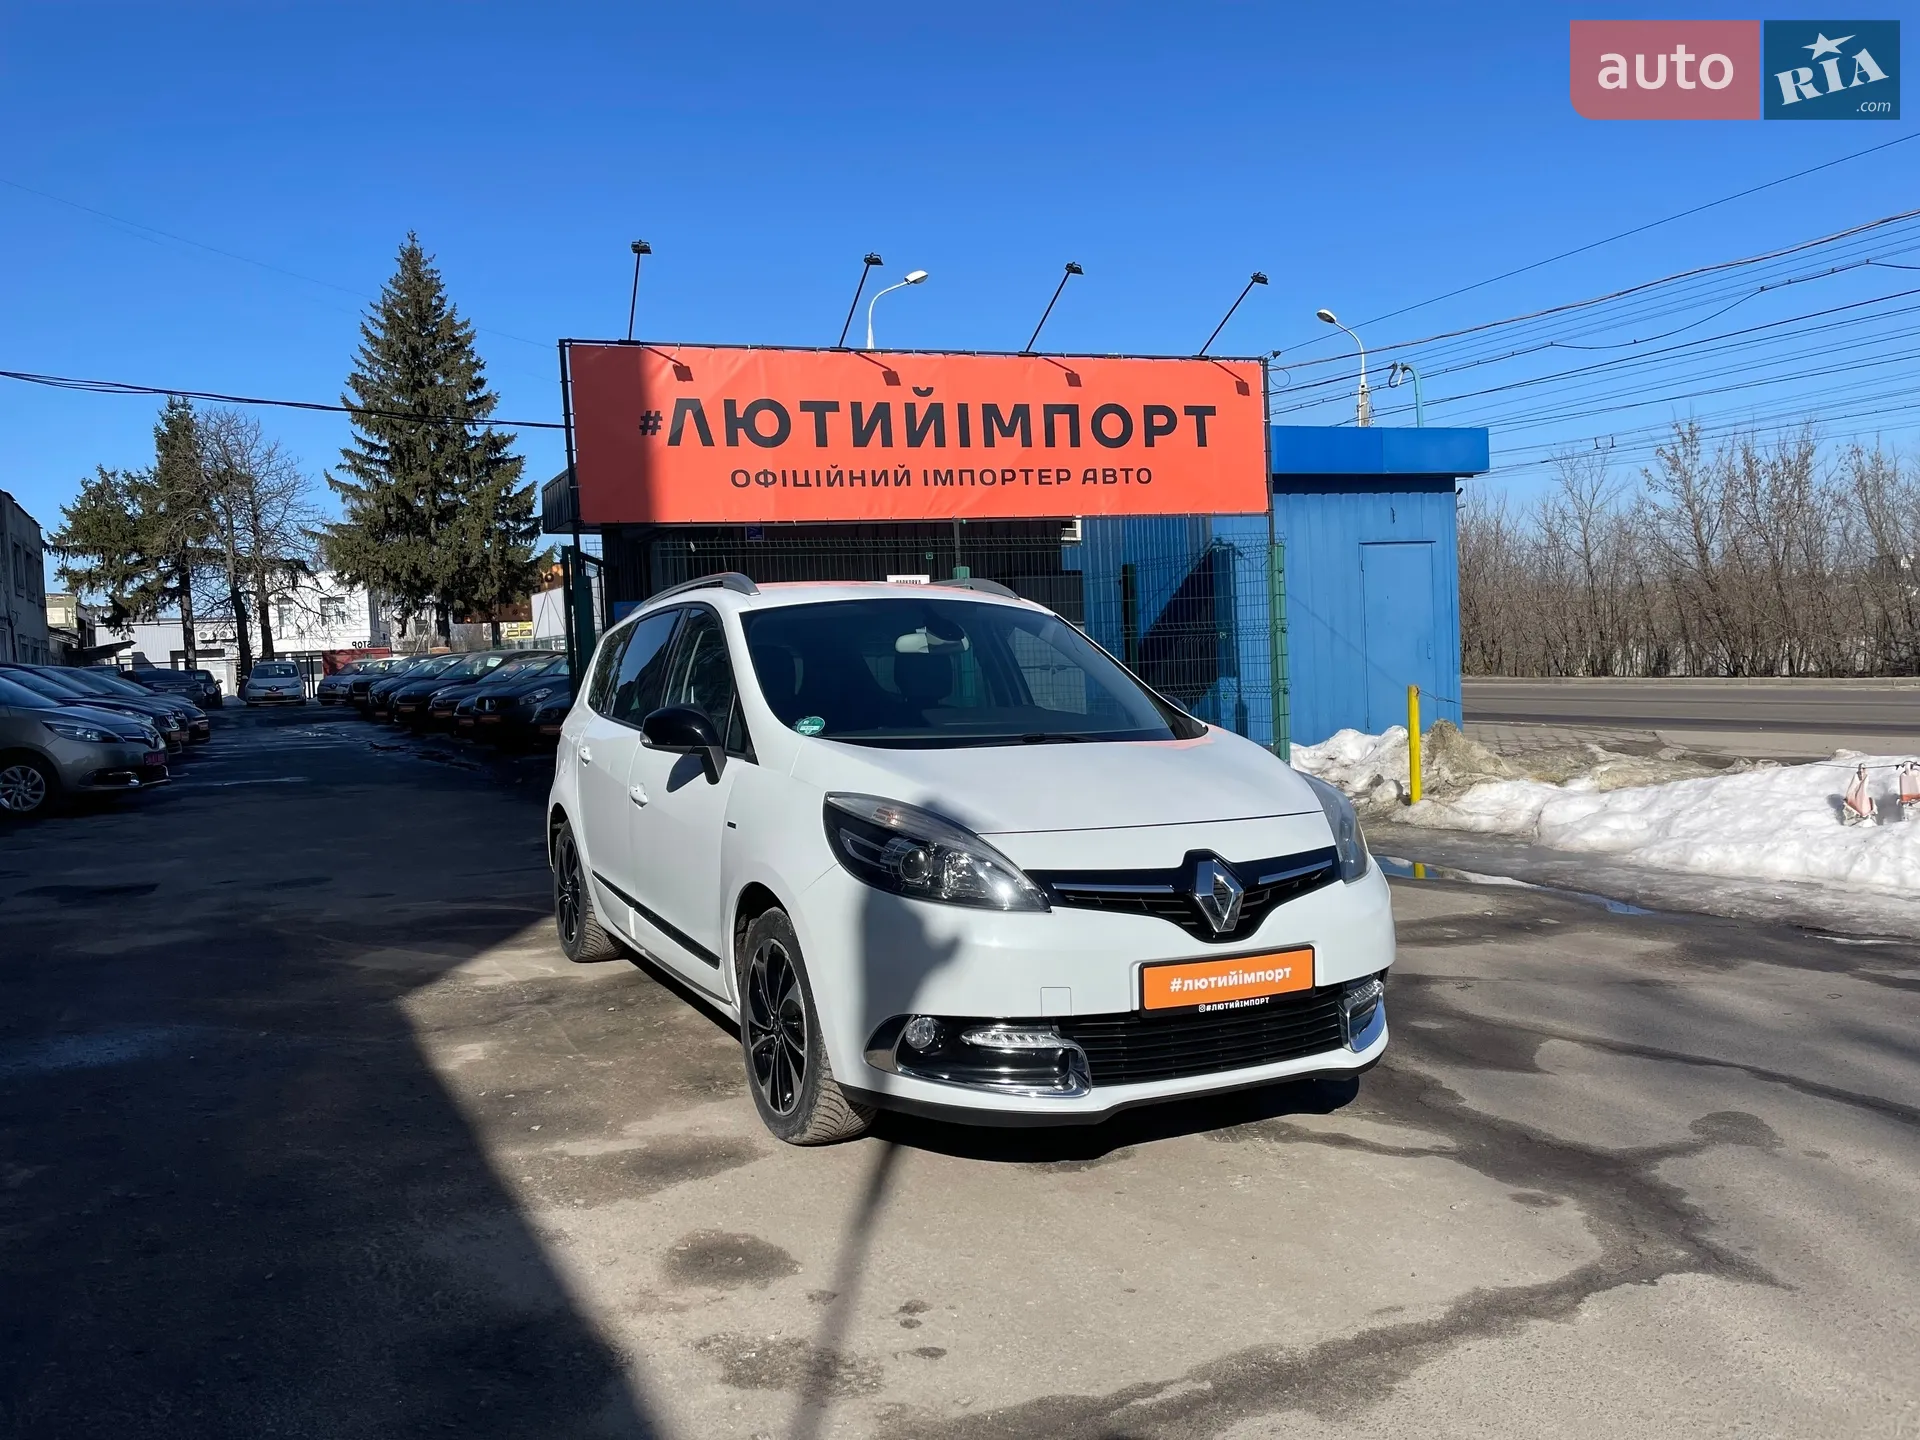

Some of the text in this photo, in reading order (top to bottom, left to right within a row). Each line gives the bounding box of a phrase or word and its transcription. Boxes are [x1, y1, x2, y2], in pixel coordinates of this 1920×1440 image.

[639, 385, 1217, 449] #ЛЮТИЙІМПОРТ
[730, 464, 1153, 489] ОФІЦІЙНИЙ ІМПОРТЕР АВТО
[1170, 967, 1292, 992] #лютийімпорт
